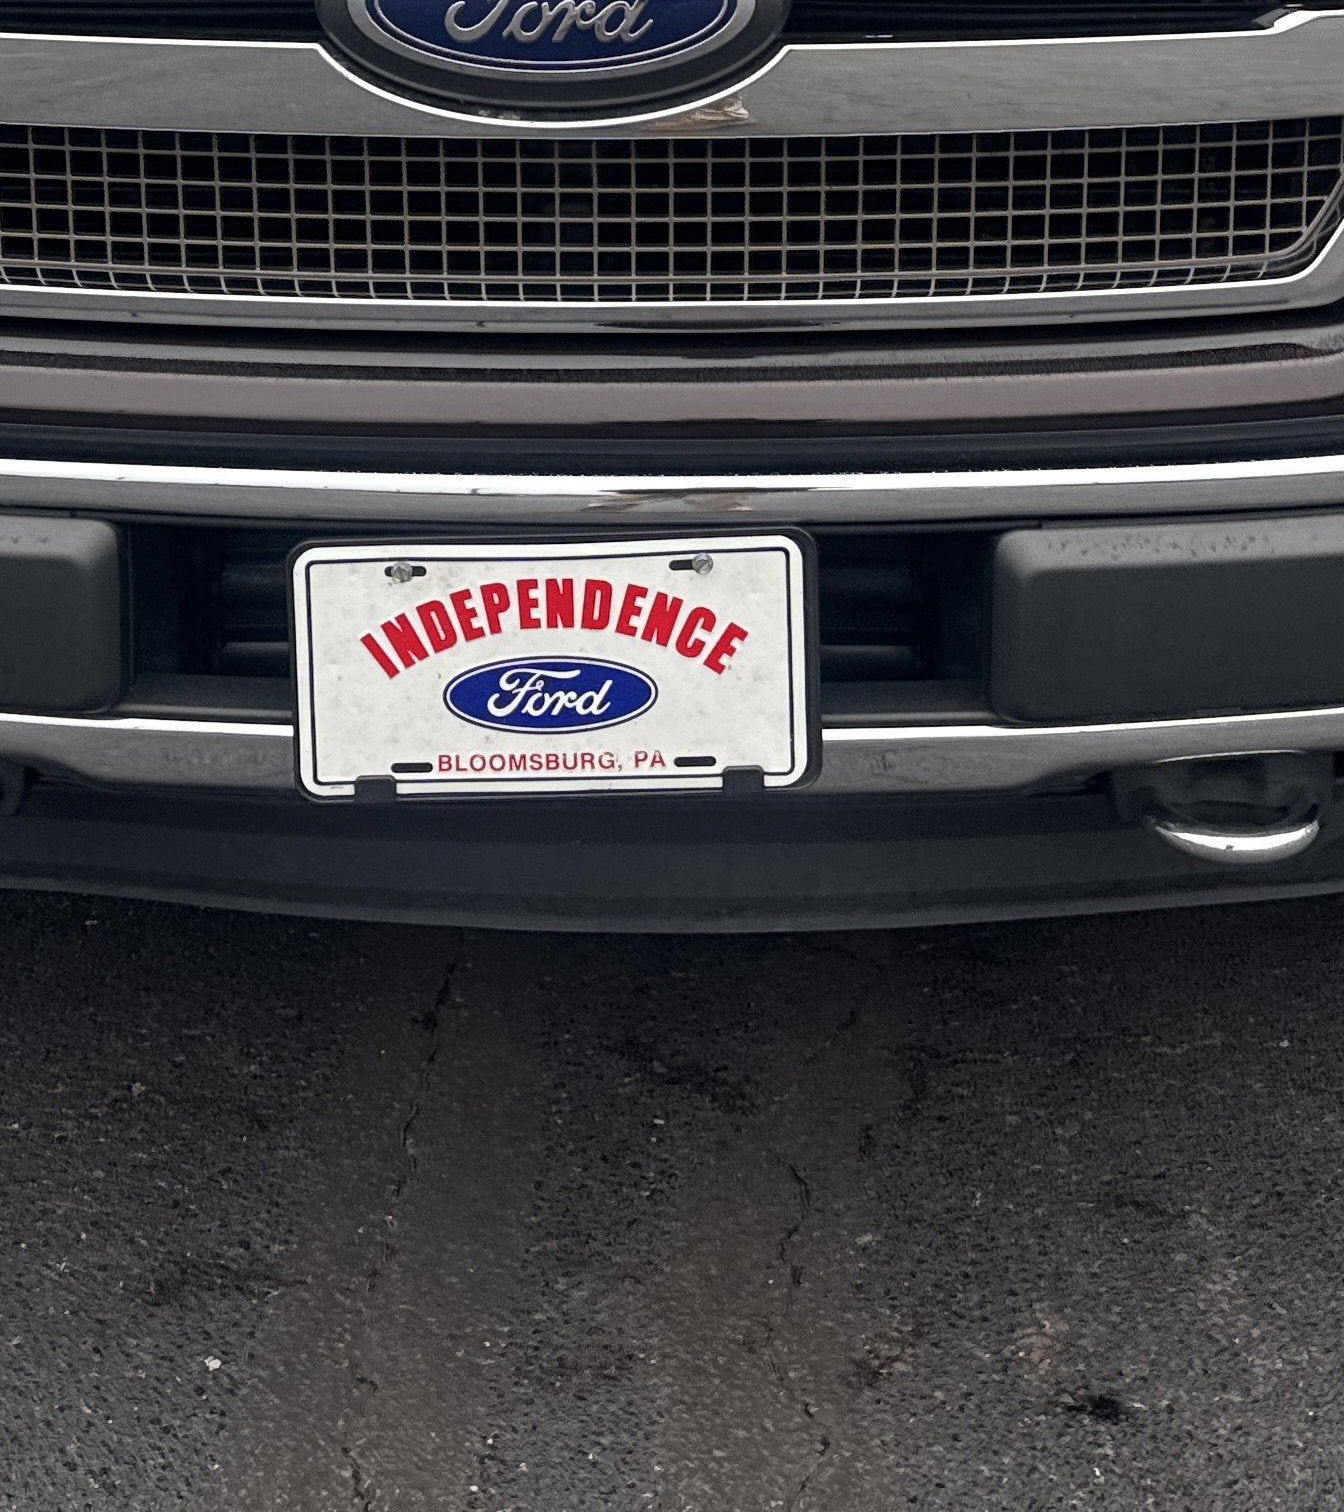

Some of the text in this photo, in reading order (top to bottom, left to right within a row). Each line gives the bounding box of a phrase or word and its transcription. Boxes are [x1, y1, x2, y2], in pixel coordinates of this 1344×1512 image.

[360, 578, 750, 680] INDEPENDENCE
[486, 668, 613, 718] Ford
[437, 750, 667, 774] BLOOMSBURG, PA
